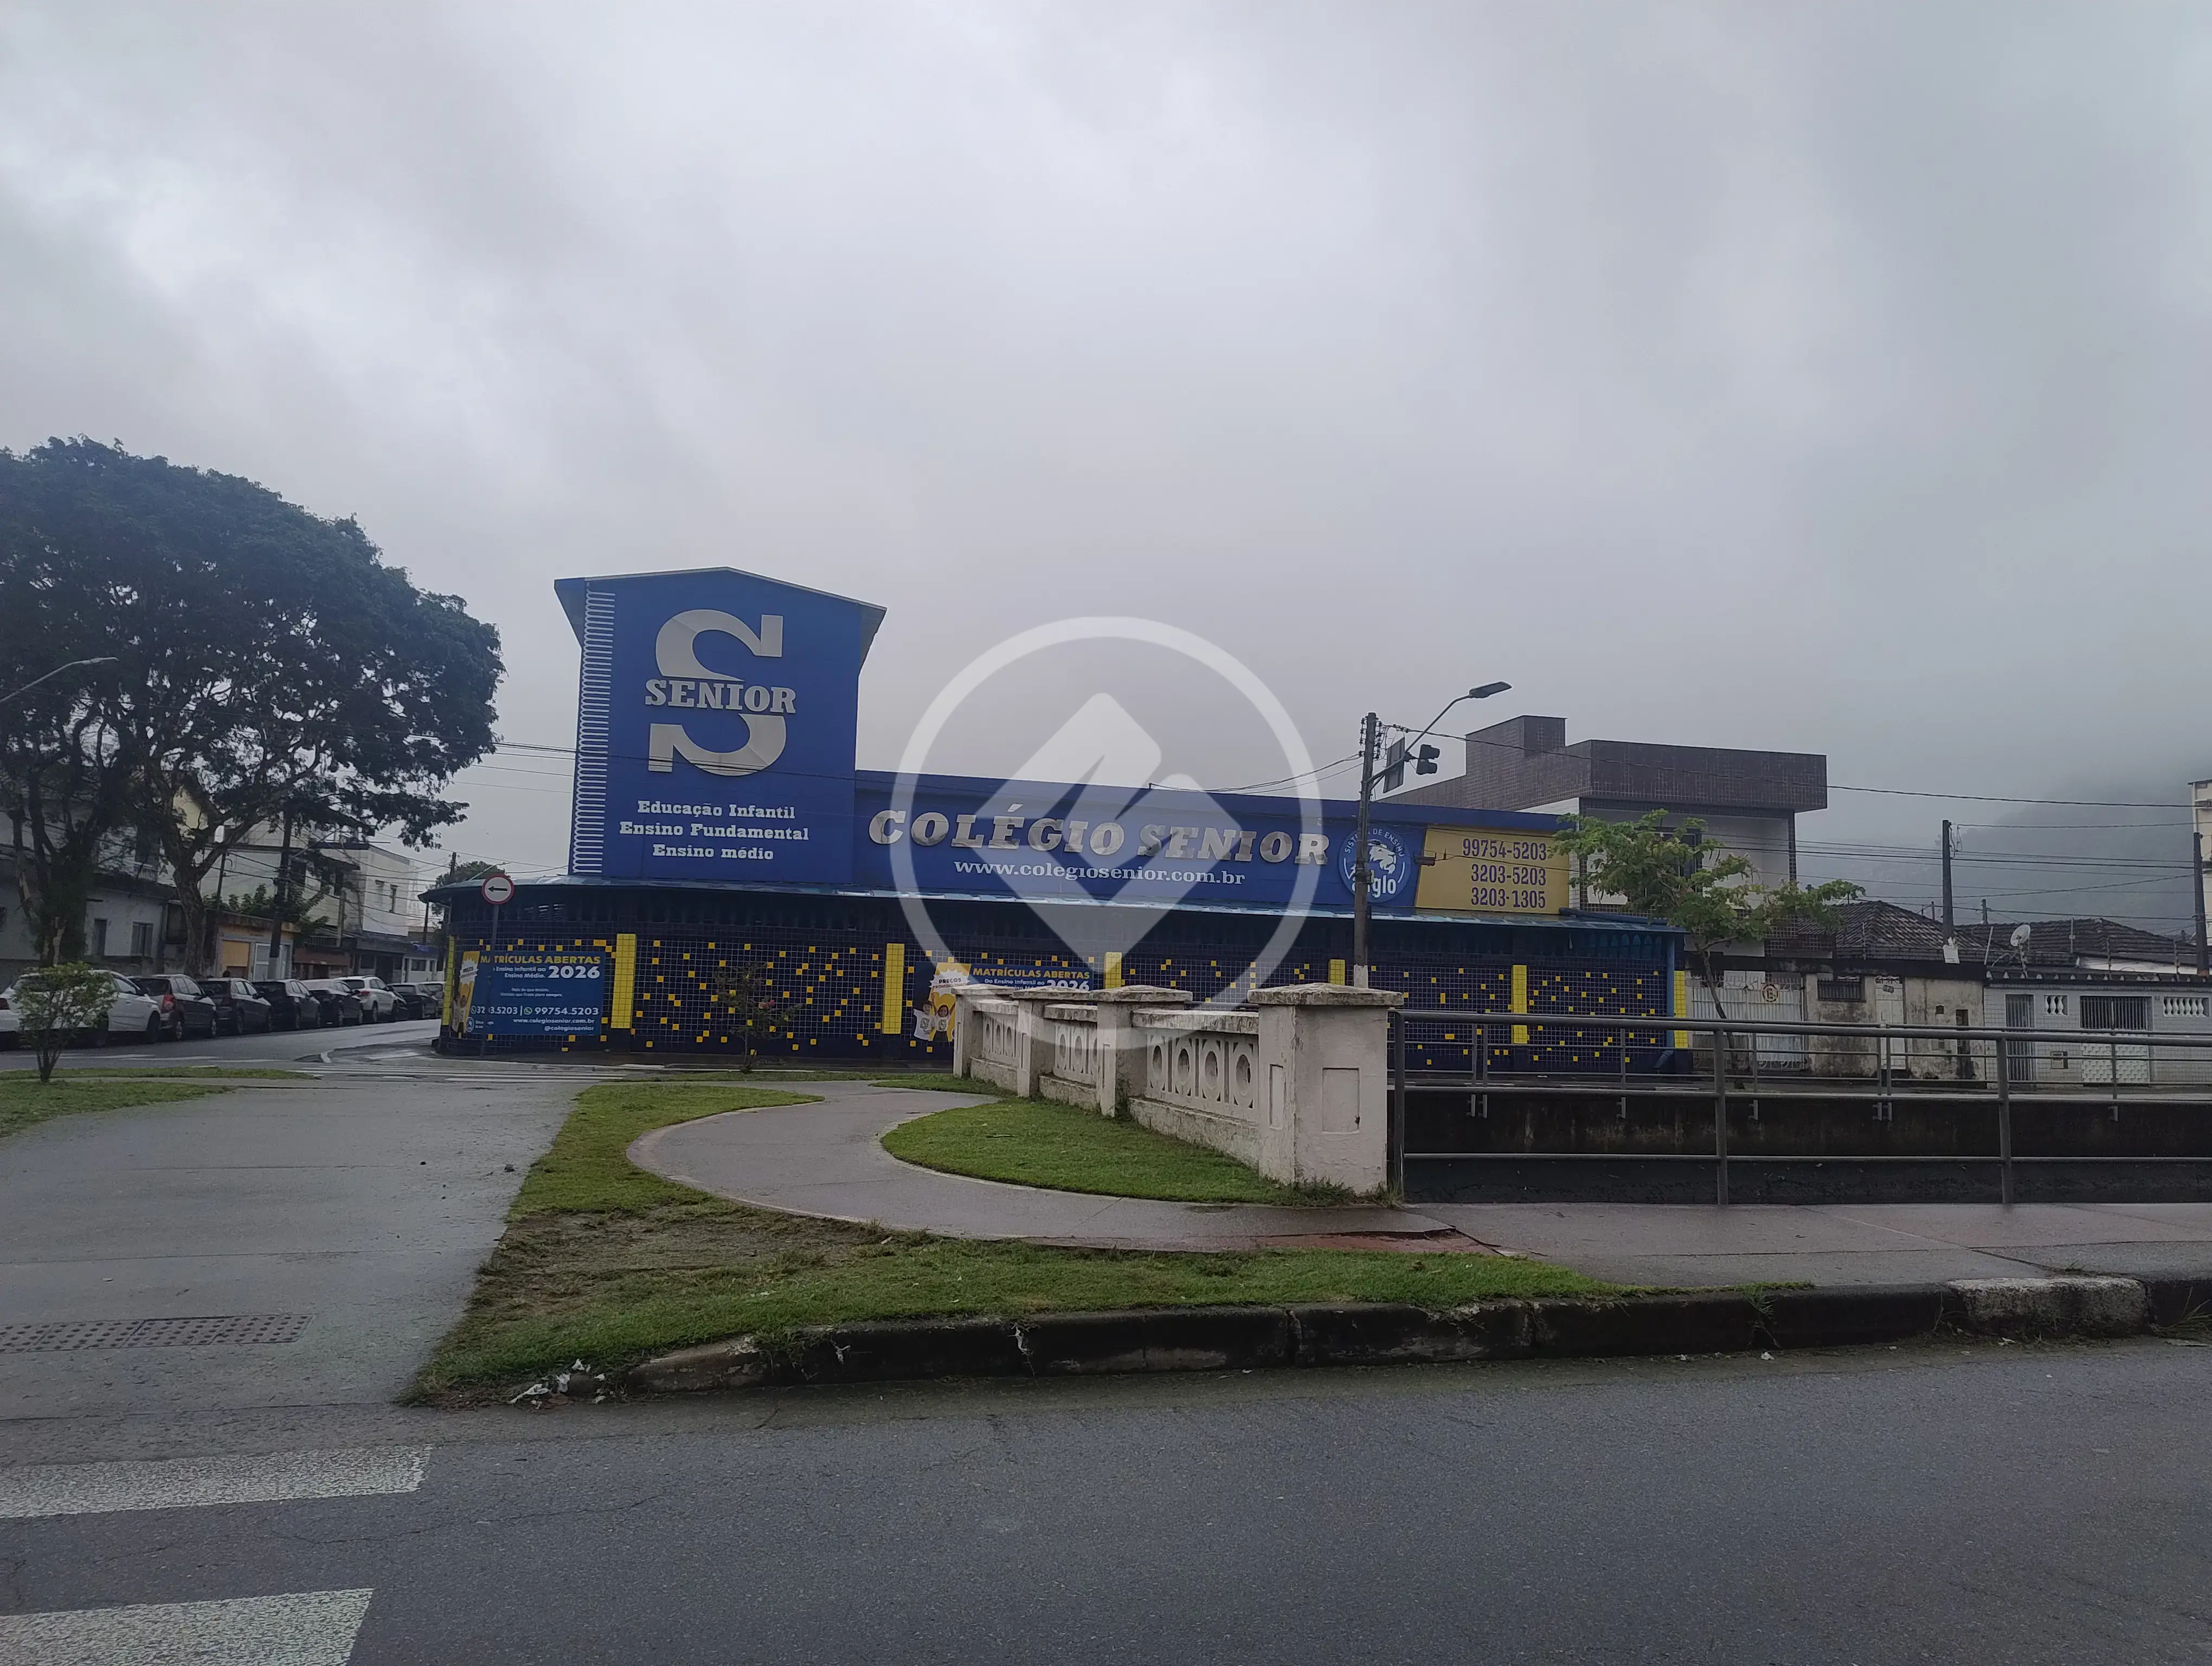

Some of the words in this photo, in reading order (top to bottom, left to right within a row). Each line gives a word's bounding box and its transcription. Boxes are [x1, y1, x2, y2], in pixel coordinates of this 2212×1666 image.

[645, 679, 796, 714] SENIOR
[637, 800, 722, 818] Educação
[729, 804, 795, 819] Infantil
[619, 821, 683, 836] Ensino
[690, 823, 809, 841] Fundamental
[869, 803, 1125, 856] COLÉGIO
[1137, 824, 1330, 865] SENIOR
[652, 843, 715, 858] Ensino
[721, 846, 774, 860] médio
[1463, 838, 1547, 861] 99754-5203
[954, 861, 1245, 885] www.colegiosenior.com.br
[1471, 863, 1547, 886] 3203-5203
[1471, 887, 1546, 909] 3203-1305
[544, 956, 601, 964] ABERTAS
[548, 965, 601, 979] 2026
[973, 967, 1041, 977] MATRÍCULAS
[1043, 970, 1090, 979] ABERTAS
[477, 1006, 518, 1015] 323.5203
